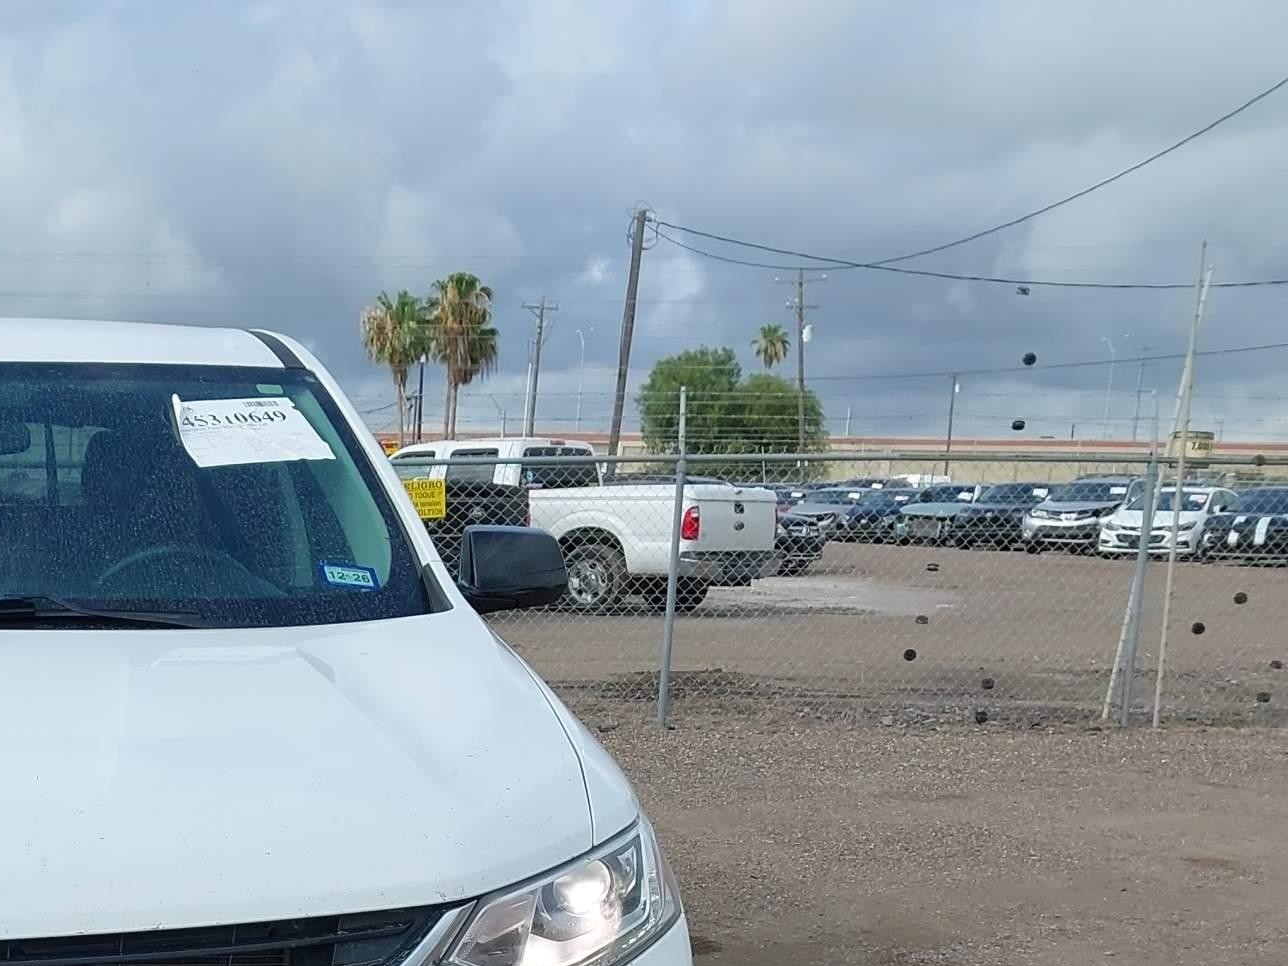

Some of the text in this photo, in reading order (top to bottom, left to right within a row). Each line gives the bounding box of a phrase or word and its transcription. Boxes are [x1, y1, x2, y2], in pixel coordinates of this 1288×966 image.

[181, 410, 287, 428] 45310649
[403, 480, 443, 490] ELIGRO
[415, 491, 436, 499] TOQUE
[418, 507, 443, 516] OLTIOS
